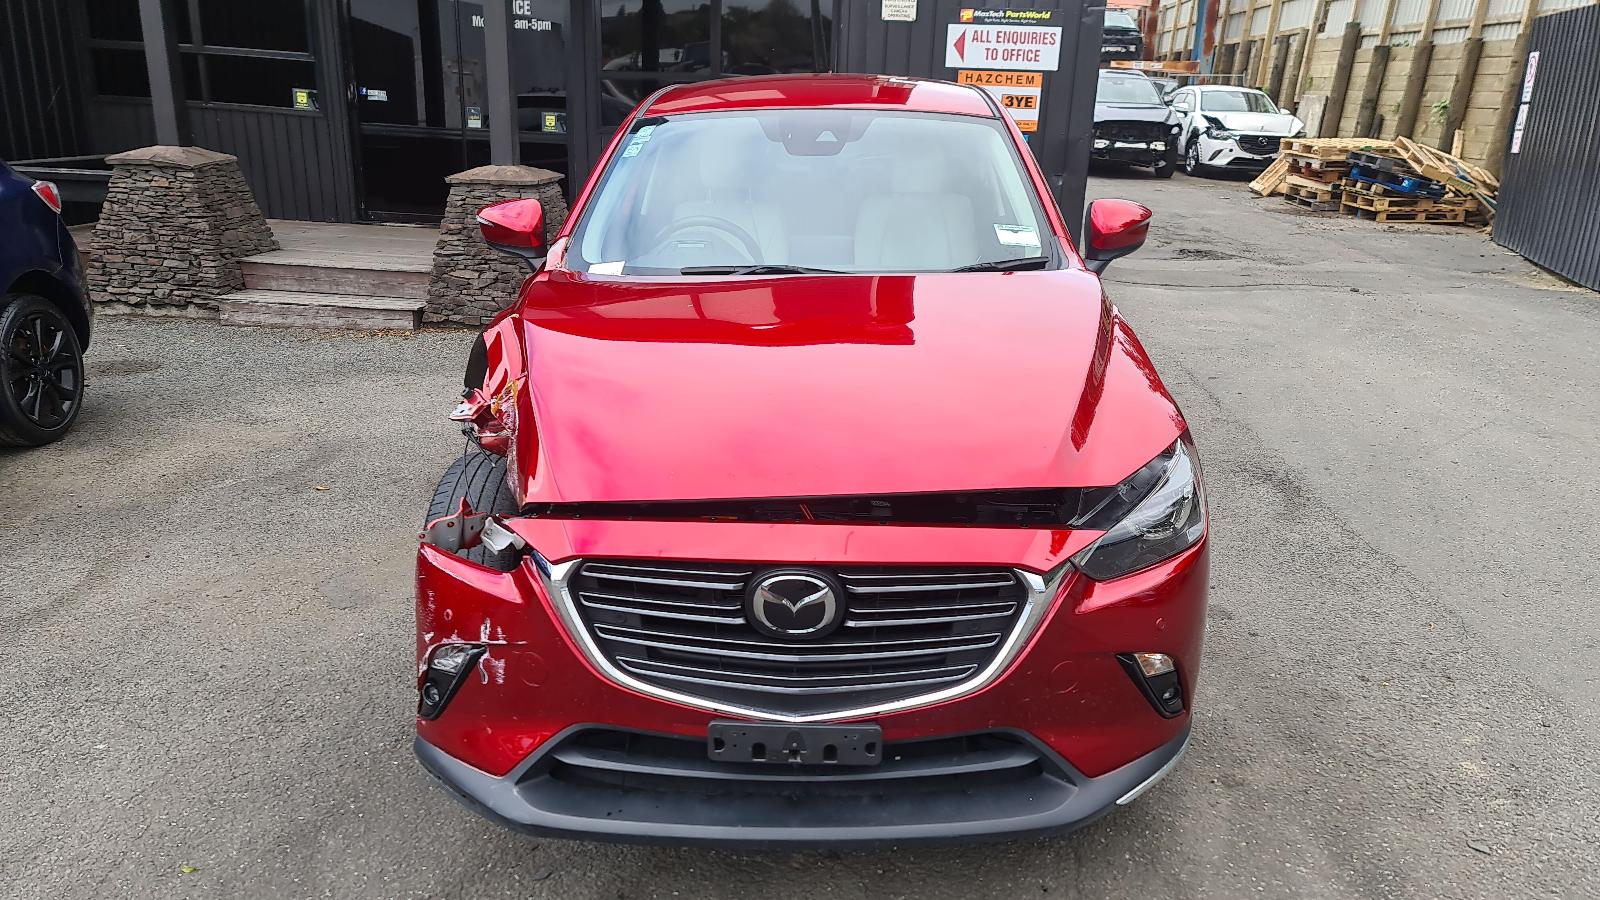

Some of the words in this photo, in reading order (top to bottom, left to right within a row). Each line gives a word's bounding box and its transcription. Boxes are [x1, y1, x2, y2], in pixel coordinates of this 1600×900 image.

[971, 29, 992, 43] ALL
[996, 30, 1057, 46] ENQUIRIES
[985, 48, 998, 61] TO
[1002, 48, 1041, 62] OFFICE
[965, 73, 1035, 85] HAZCHEM
[1004, 95, 1034, 108] 3YE
